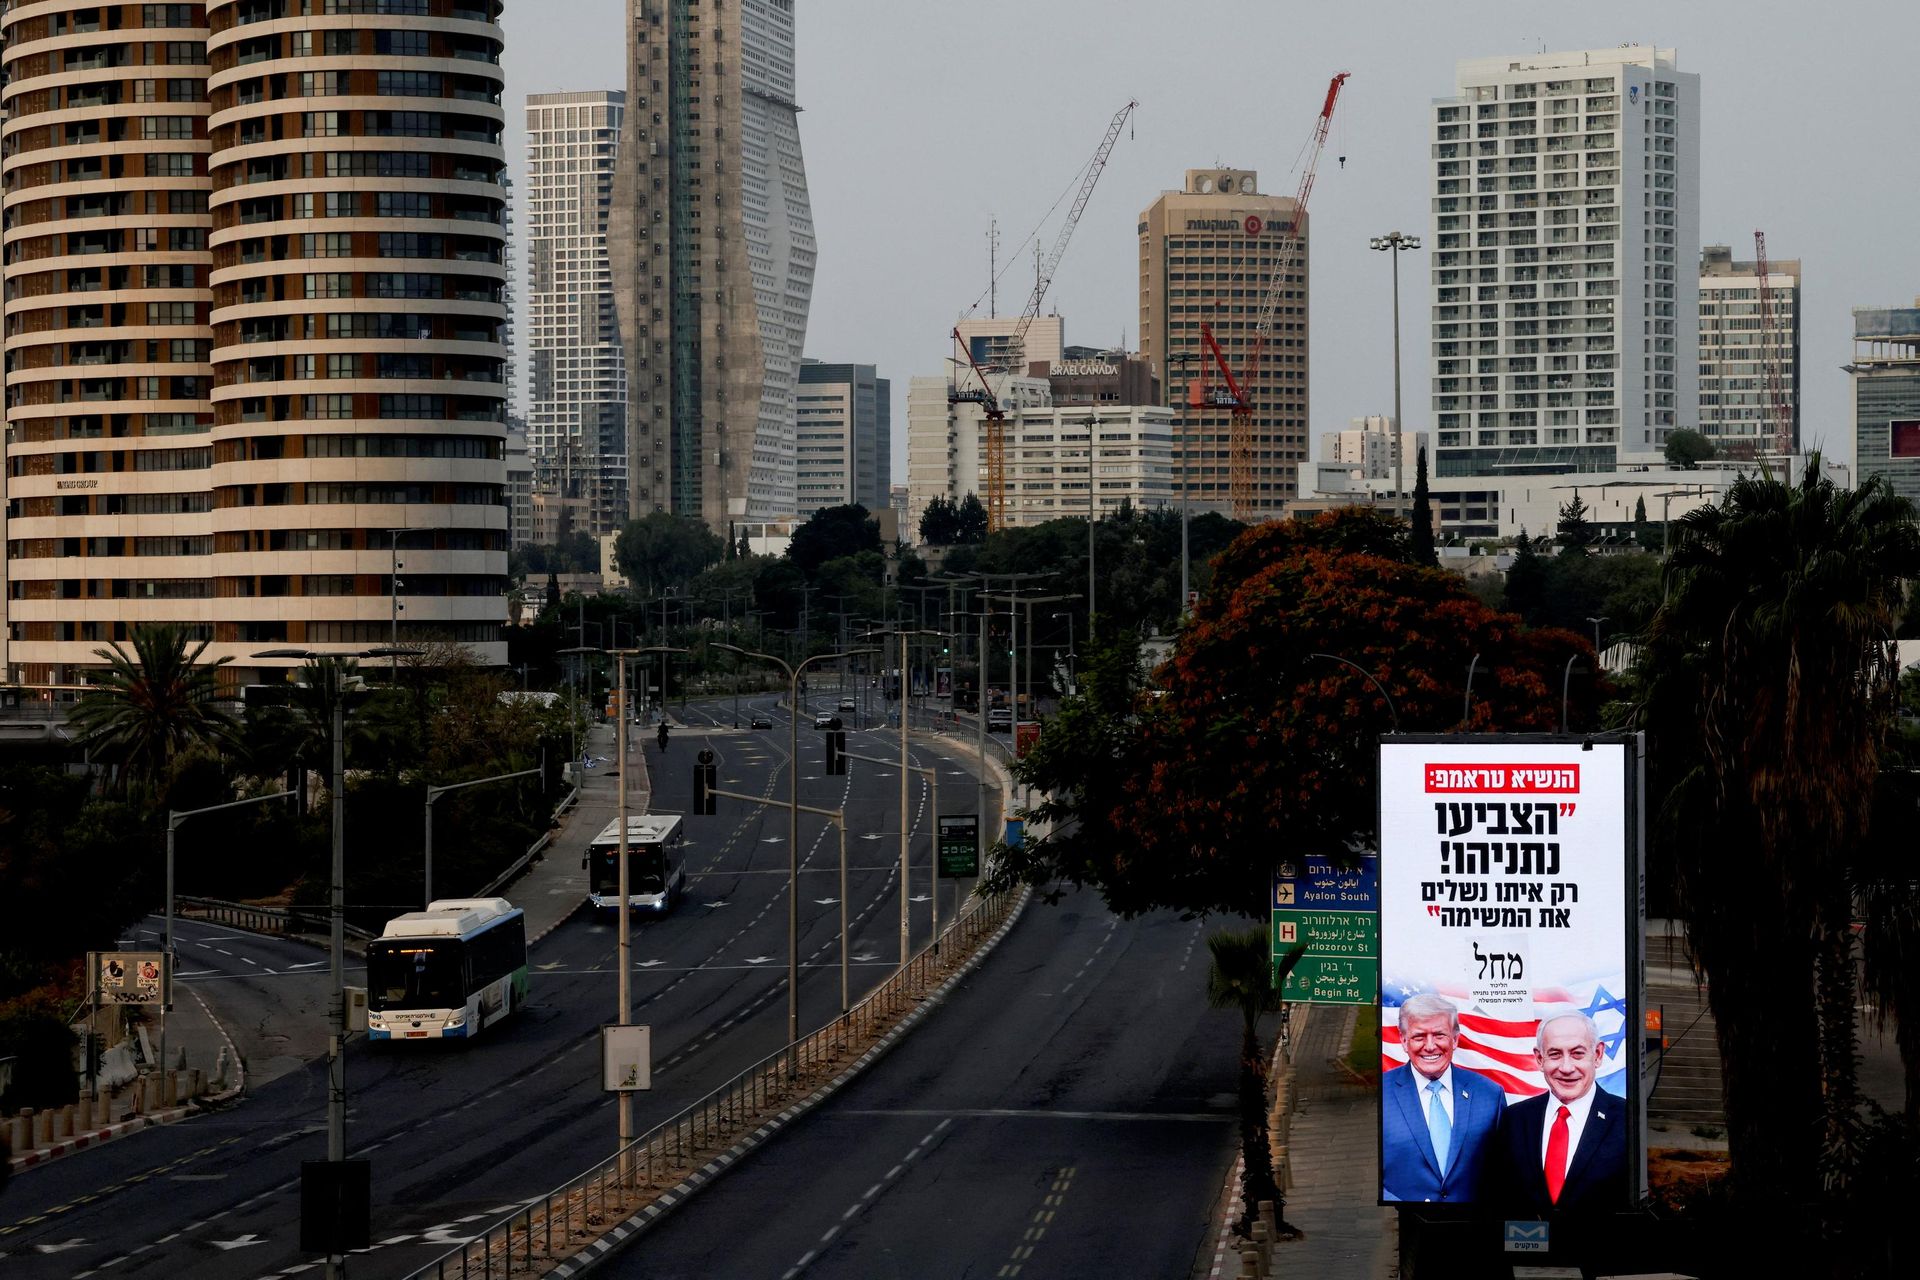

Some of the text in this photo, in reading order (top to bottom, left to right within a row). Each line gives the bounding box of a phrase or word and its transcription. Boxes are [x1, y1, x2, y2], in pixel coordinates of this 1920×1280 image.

[1187, 219, 1239, 232] השקעות
[1050, 364, 1118, 375] ISRAEL CANADA
[1429, 769, 1575, 788] הנשיא טראמפ:
[1440, 841, 1560, 874] נתניהו!
[1309, 865, 1332, 874] דרום
[1314, 879, 1336, 889] جنوب
[1304, 891, 1370, 901] Ayalon South
[1421, 879, 1578, 906] רק איתו נשלים
[1302, 914, 1371, 926] רח' ארלוזורוב
[1539, 908, 1571, 928] את
[1347, 930, 1366, 941] شارع
[1358, 943, 1368, 952] St
[1473, 941, 1523, 980] מחל
[1320, 962, 1338, 973] בגין
[1337, 974, 1359, 986] طريق
[1314, 988, 1359, 998] Begin Rd
